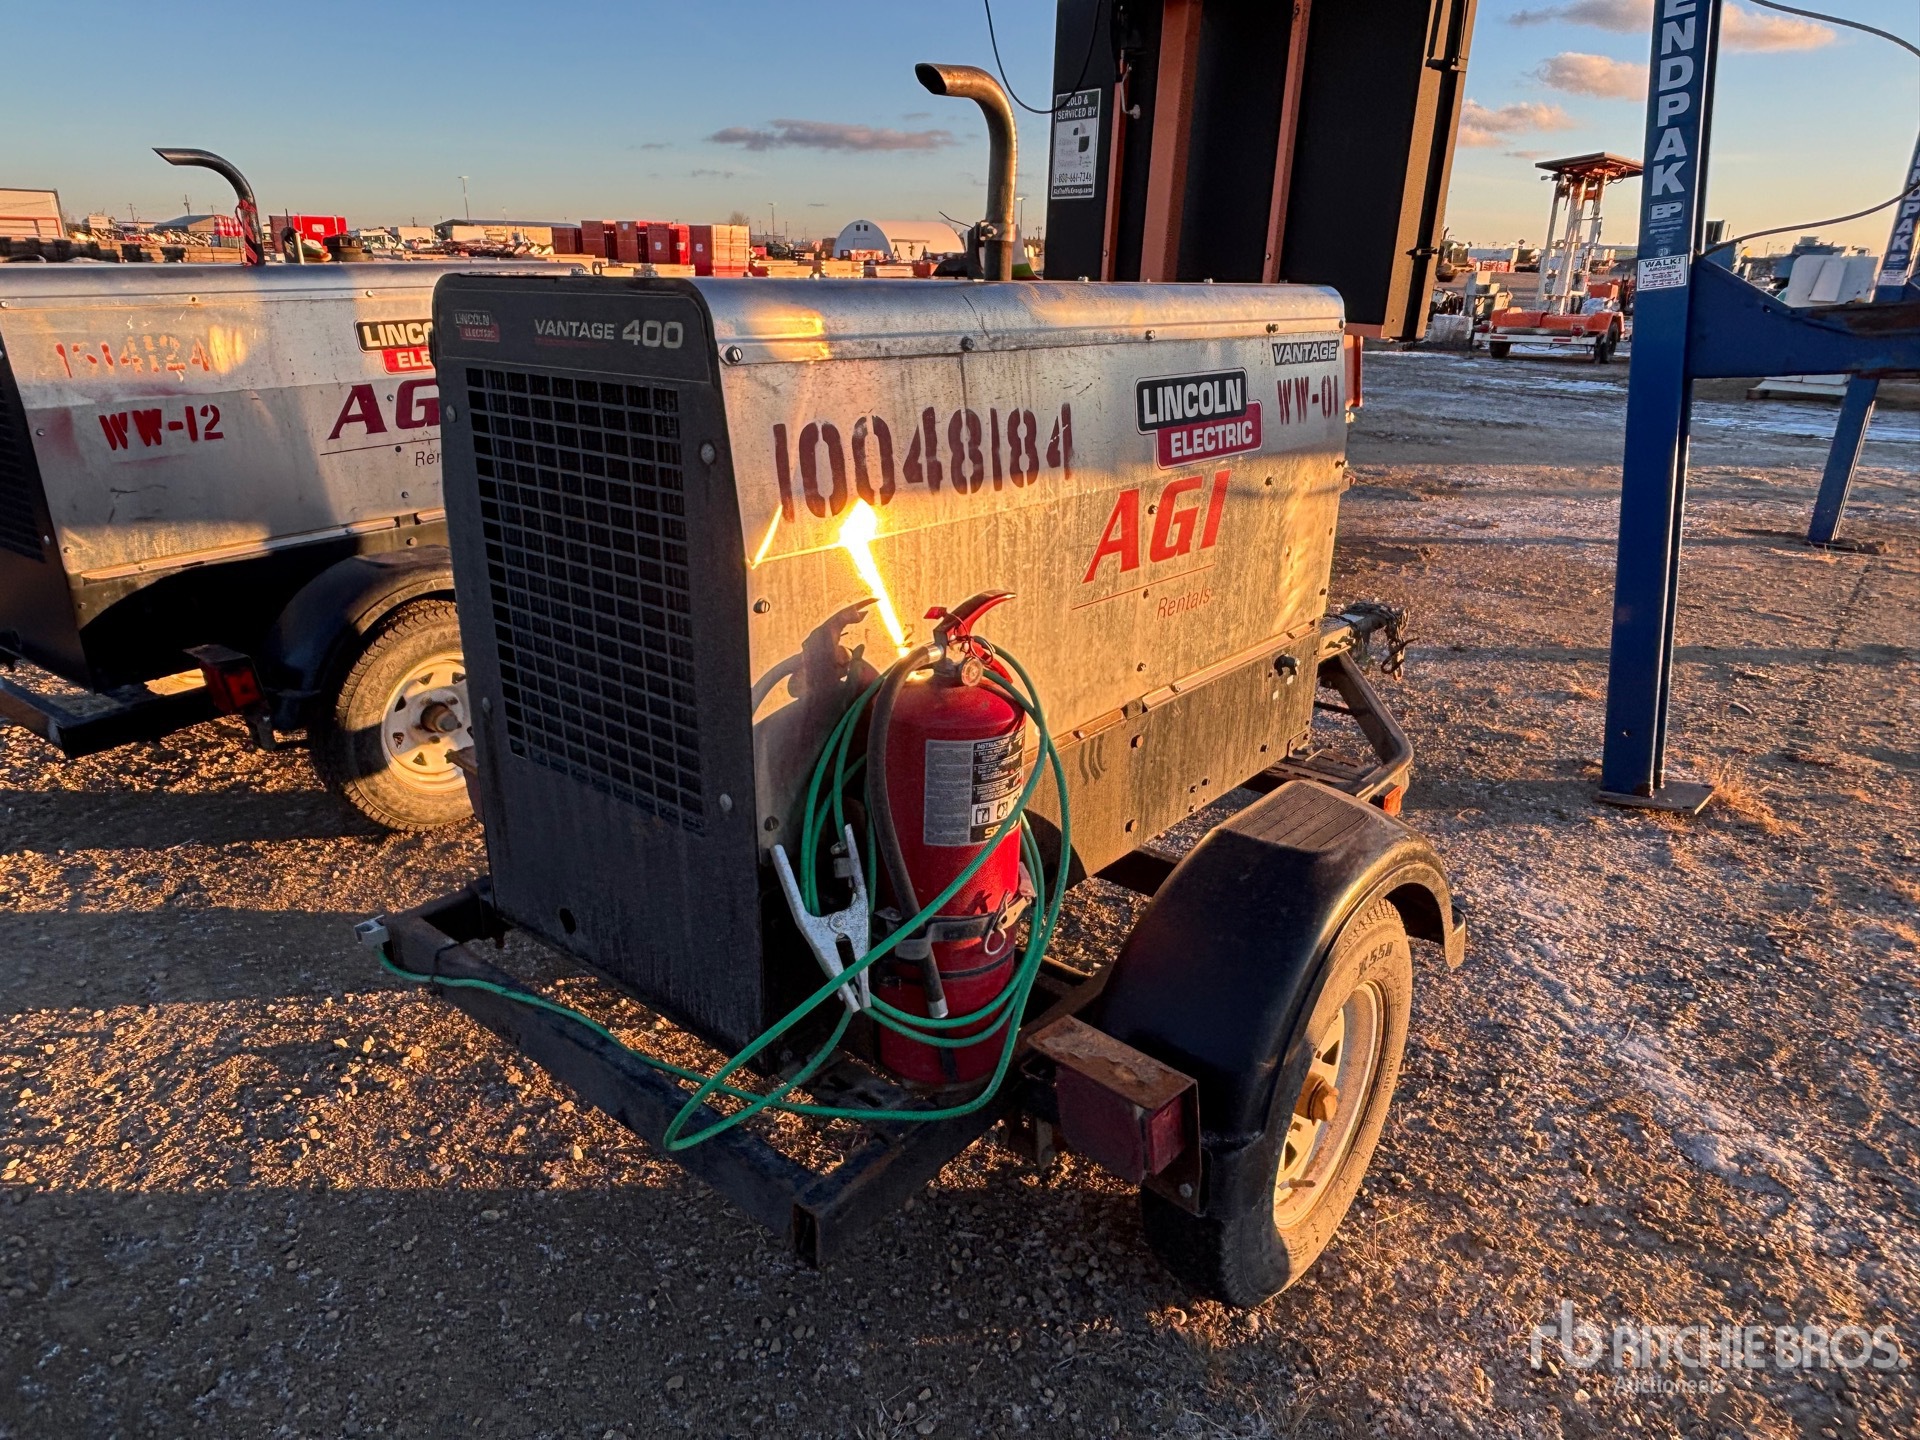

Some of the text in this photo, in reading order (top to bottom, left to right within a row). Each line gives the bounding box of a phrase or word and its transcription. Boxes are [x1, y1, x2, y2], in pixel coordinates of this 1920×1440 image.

[1057, 106, 1097, 120] SERVICED BY
[1651, 202, 1683, 220] BP
[1644, 258, 1681, 268] WALK!
[455, 313, 490, 326] LINCOLN
[534, 319, 684, 349] VANTAGE 400
[1272, 341, 1339, 364] VANTAGE
[1142, 378, 1242, 424] LINCOLN
[98, 404, 225, 451] WW-12
[1170, 420, 1253, 458] ELECTRIC
[772, 402, 1073, 524] 10048184
[1082, 469, 1232, 584] AGI
[1156, 585, 1212, 620] Rentals
